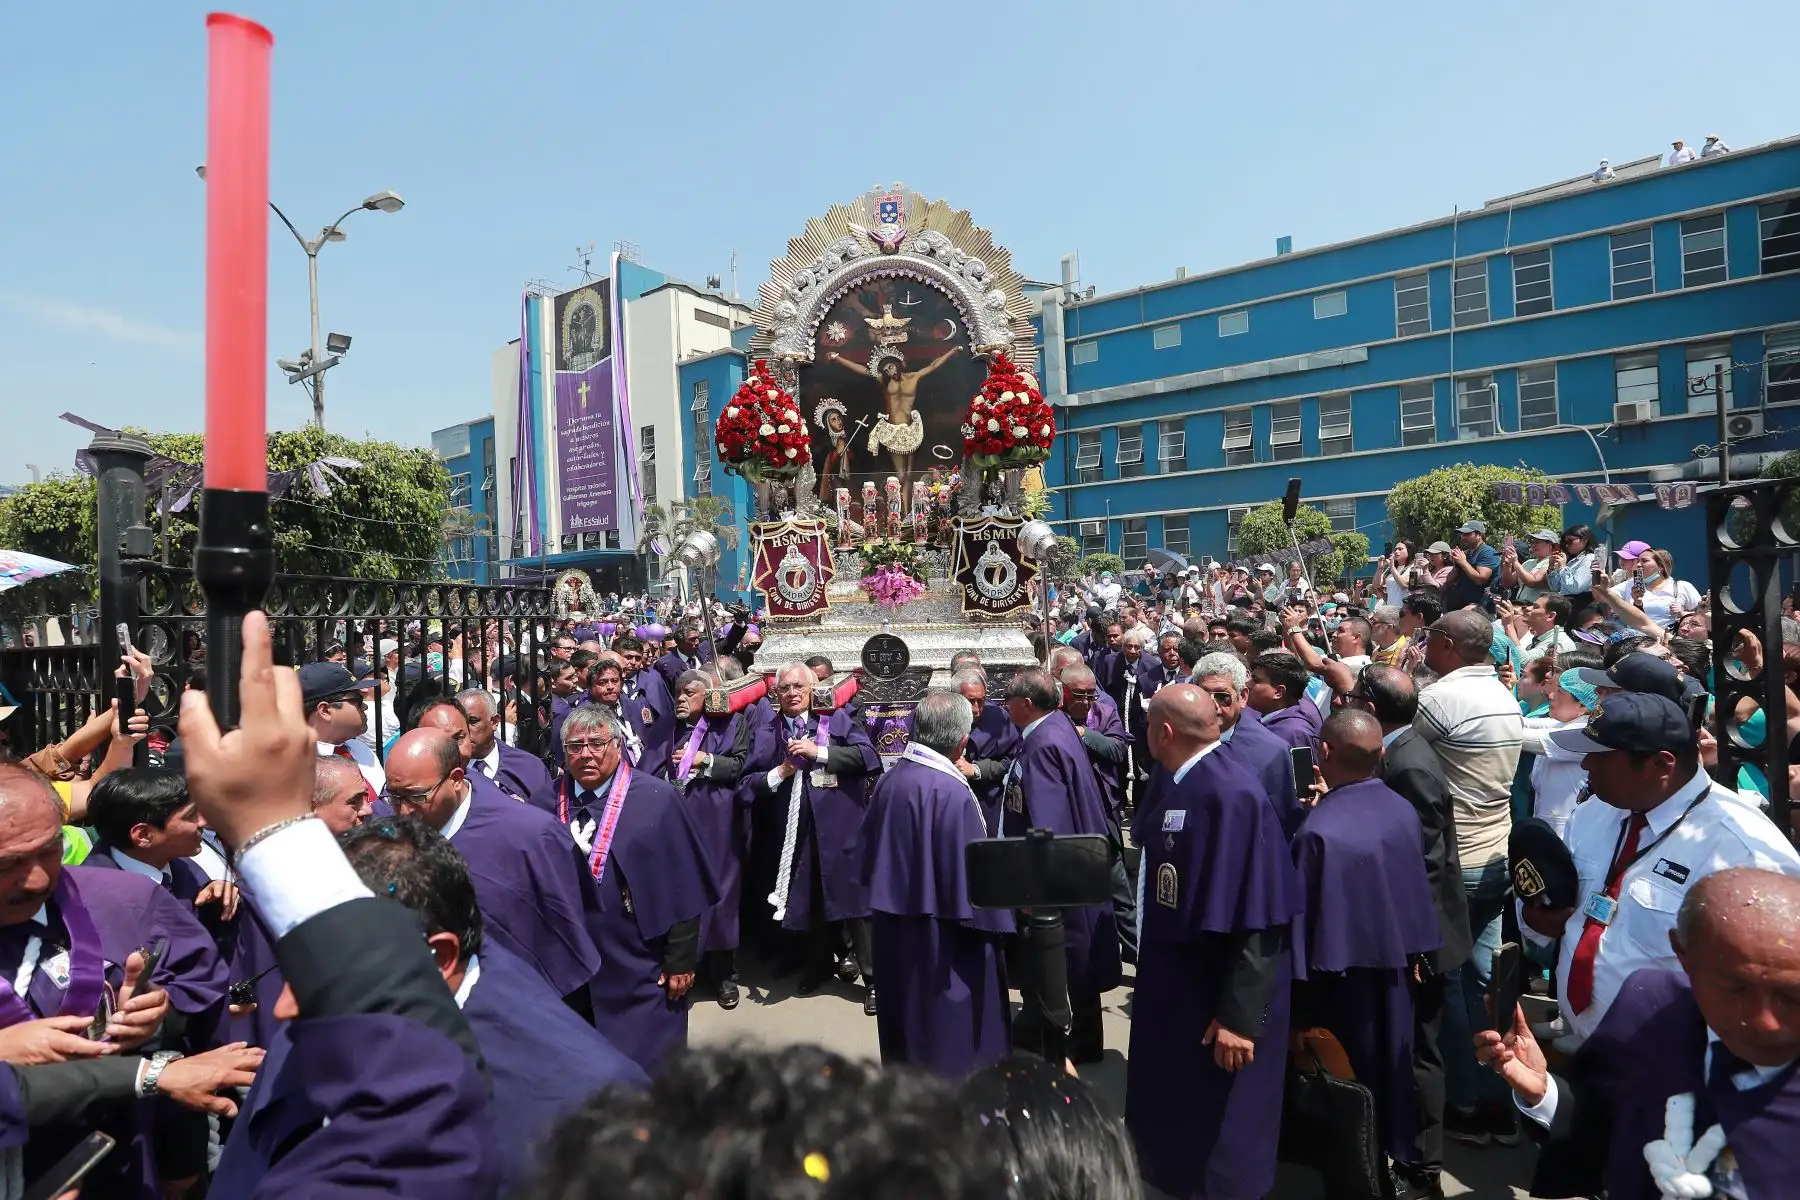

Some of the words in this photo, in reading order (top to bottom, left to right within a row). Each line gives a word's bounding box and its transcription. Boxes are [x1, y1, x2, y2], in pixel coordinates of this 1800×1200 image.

[584, 515, 609, 527] EsSalud
[772, 533, 811, 548] HSMN
[973, 529, 1016, 541] HSMN
[780, 581, 815, 599] CUADRILLA
[977, 579, 1016, 597] CUADRILLA
[980, 597, 989, 607] DE
[992, 581, 1028, 608] DIRIGENTE
[784, 601, 794, 610] DE
